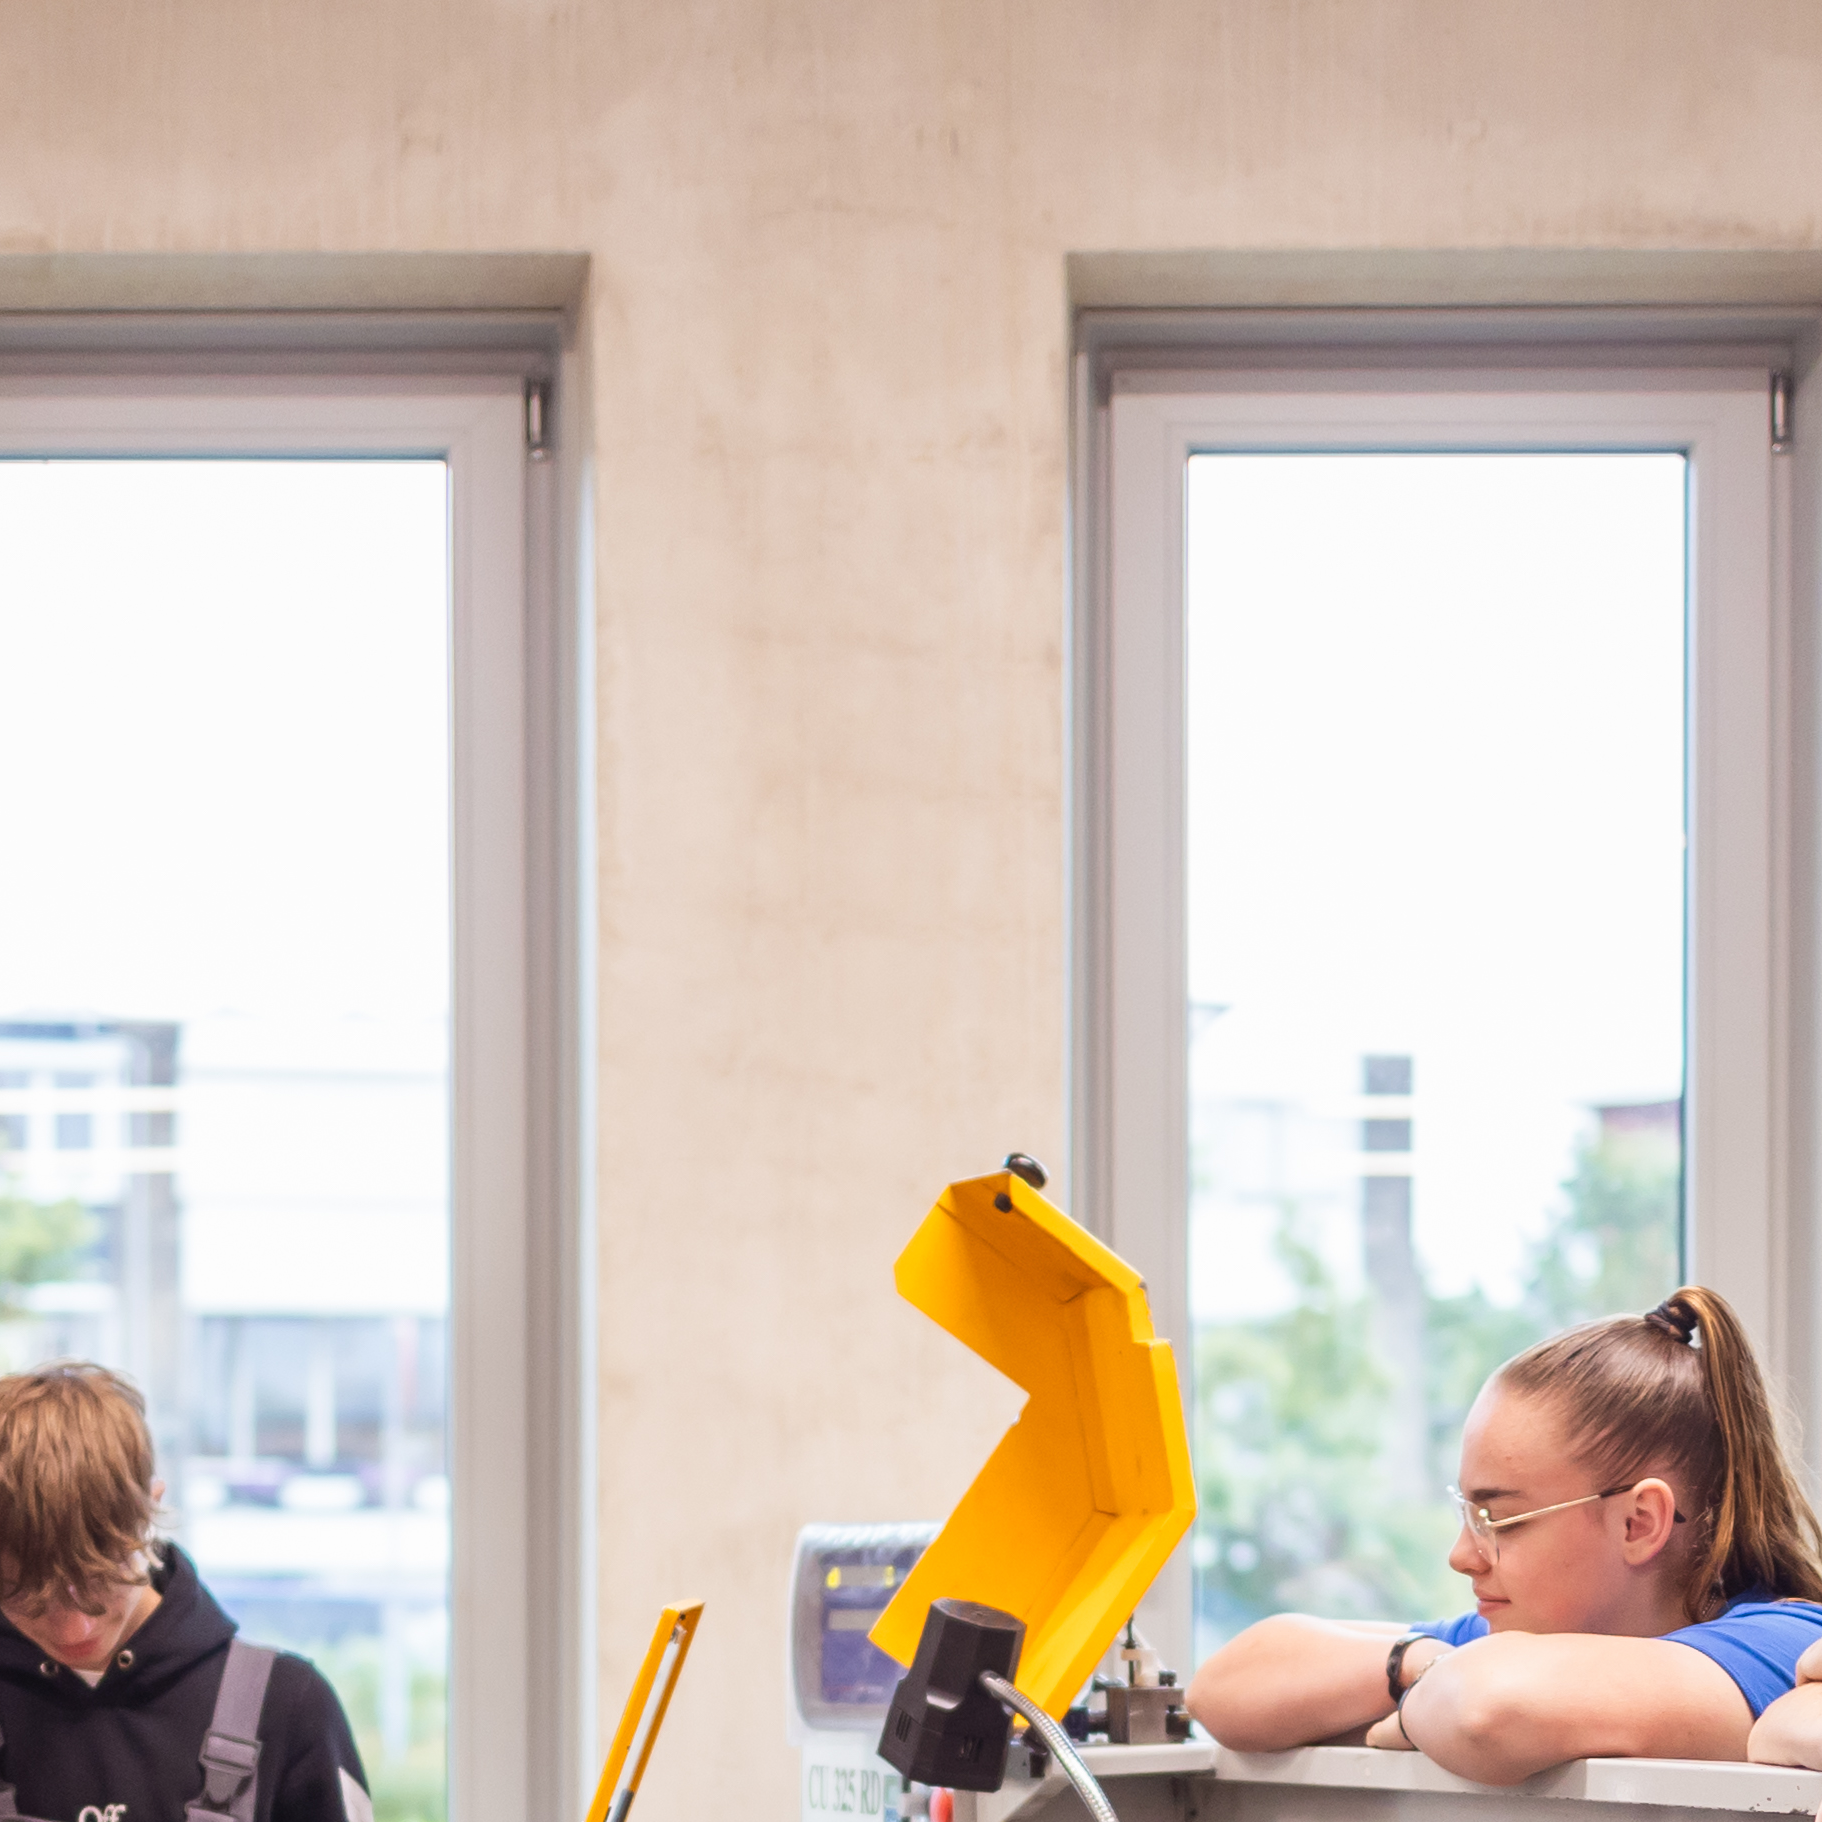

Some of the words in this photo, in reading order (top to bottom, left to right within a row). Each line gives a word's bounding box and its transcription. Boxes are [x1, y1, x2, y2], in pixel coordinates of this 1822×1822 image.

[808, 1765, 828, 1811] CU
[833, 1767, 855, 1814] 325
[860, 1769, 881, 1815] RD
